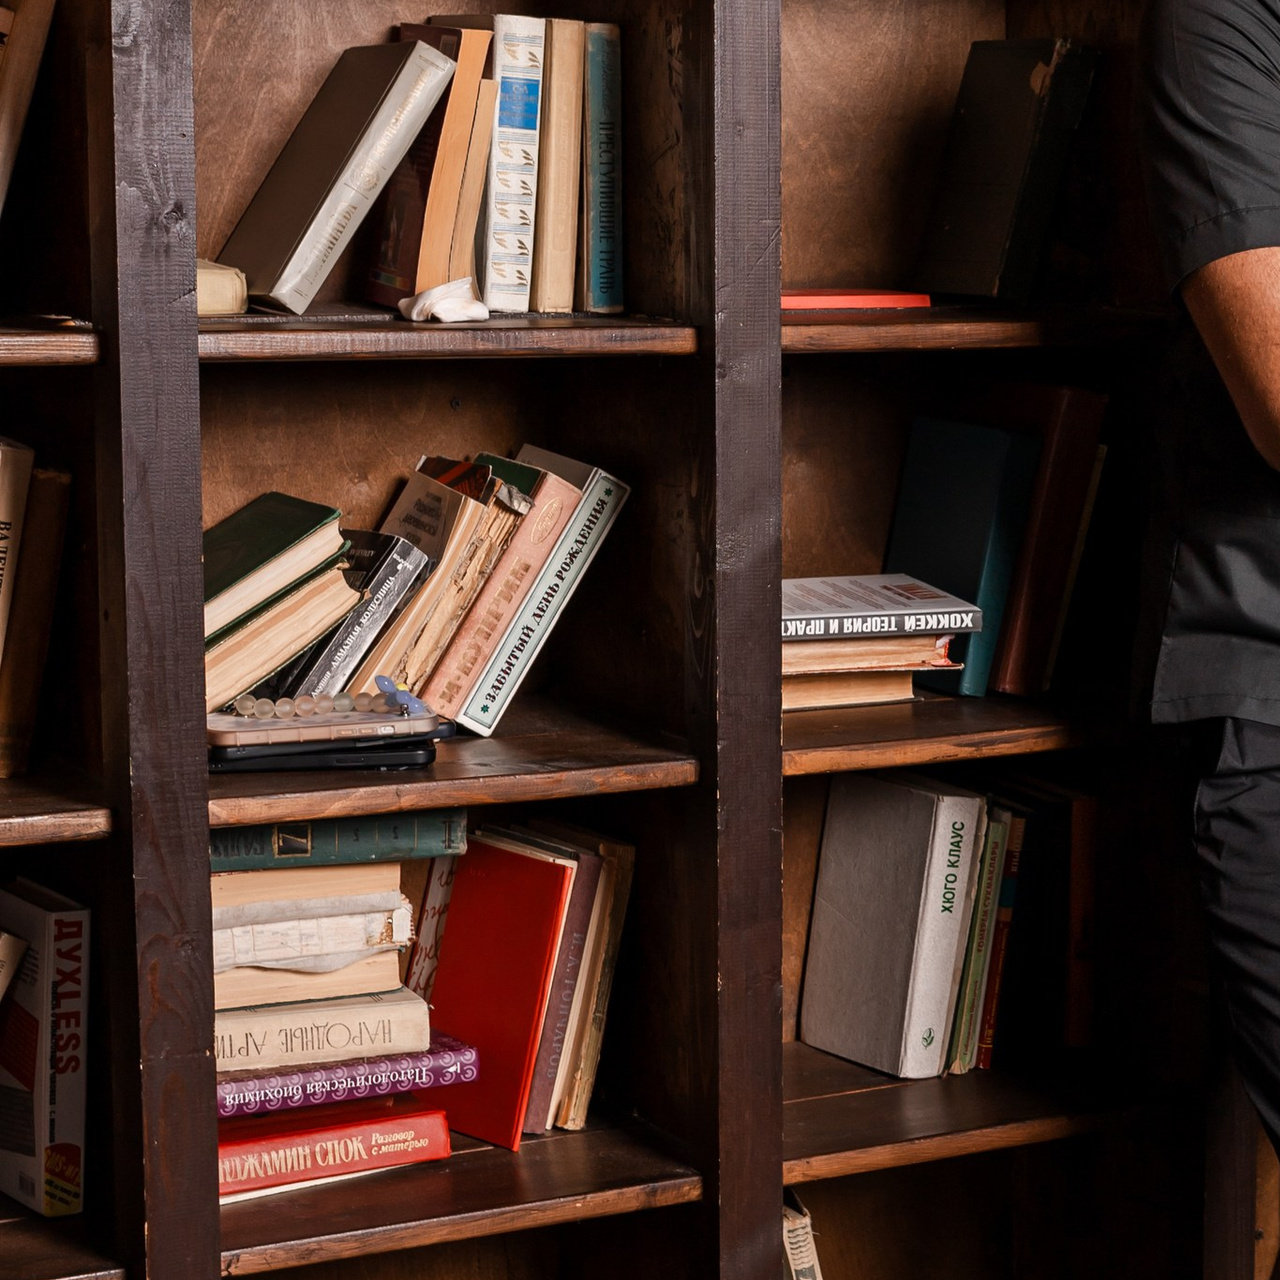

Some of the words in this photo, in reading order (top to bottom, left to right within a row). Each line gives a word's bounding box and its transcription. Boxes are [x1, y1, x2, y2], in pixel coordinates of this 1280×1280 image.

[598, 120, 616, 243] ПРЕСТУПИВШИЕ
[599, 249, 616, 294] ГРАНЬ
[480, 622, 539, 704] ЗАБЫТЫЙ
[528, 579, 563, 626] ДЕНЬ
[550, 494, 613, 583] РОЖДЕНИЯ
[328, 624, 363, 669] АЛМАЗНАЯ
[358, 574, 397, 626] КОЛЕСНИЦА
[829, 619, 839, 634] И
[843, 616, 898, 632] ТЕОРИЯ
[904, 612, 974, 632] ХОККЕЙ
[944, 819, 966, 869] КЛАУС
[940, 872, 959, 914] ХЮГО
[53, 919, 83, 1076] ДУХLESS
[276, 1020, 392, 1053] НАРОДНЫЕ
[539, 977, 580, 1081] ГОНЧАРОВ
[223, 1082, 302, 1110] биохимия
[305, 1064, 426, 1098] Патологическая
[313, 1133, 369, 1168] СПОК
[368, 1126, 416, 1146] Разговор
[377, 1136, 430, 1155] матерью
